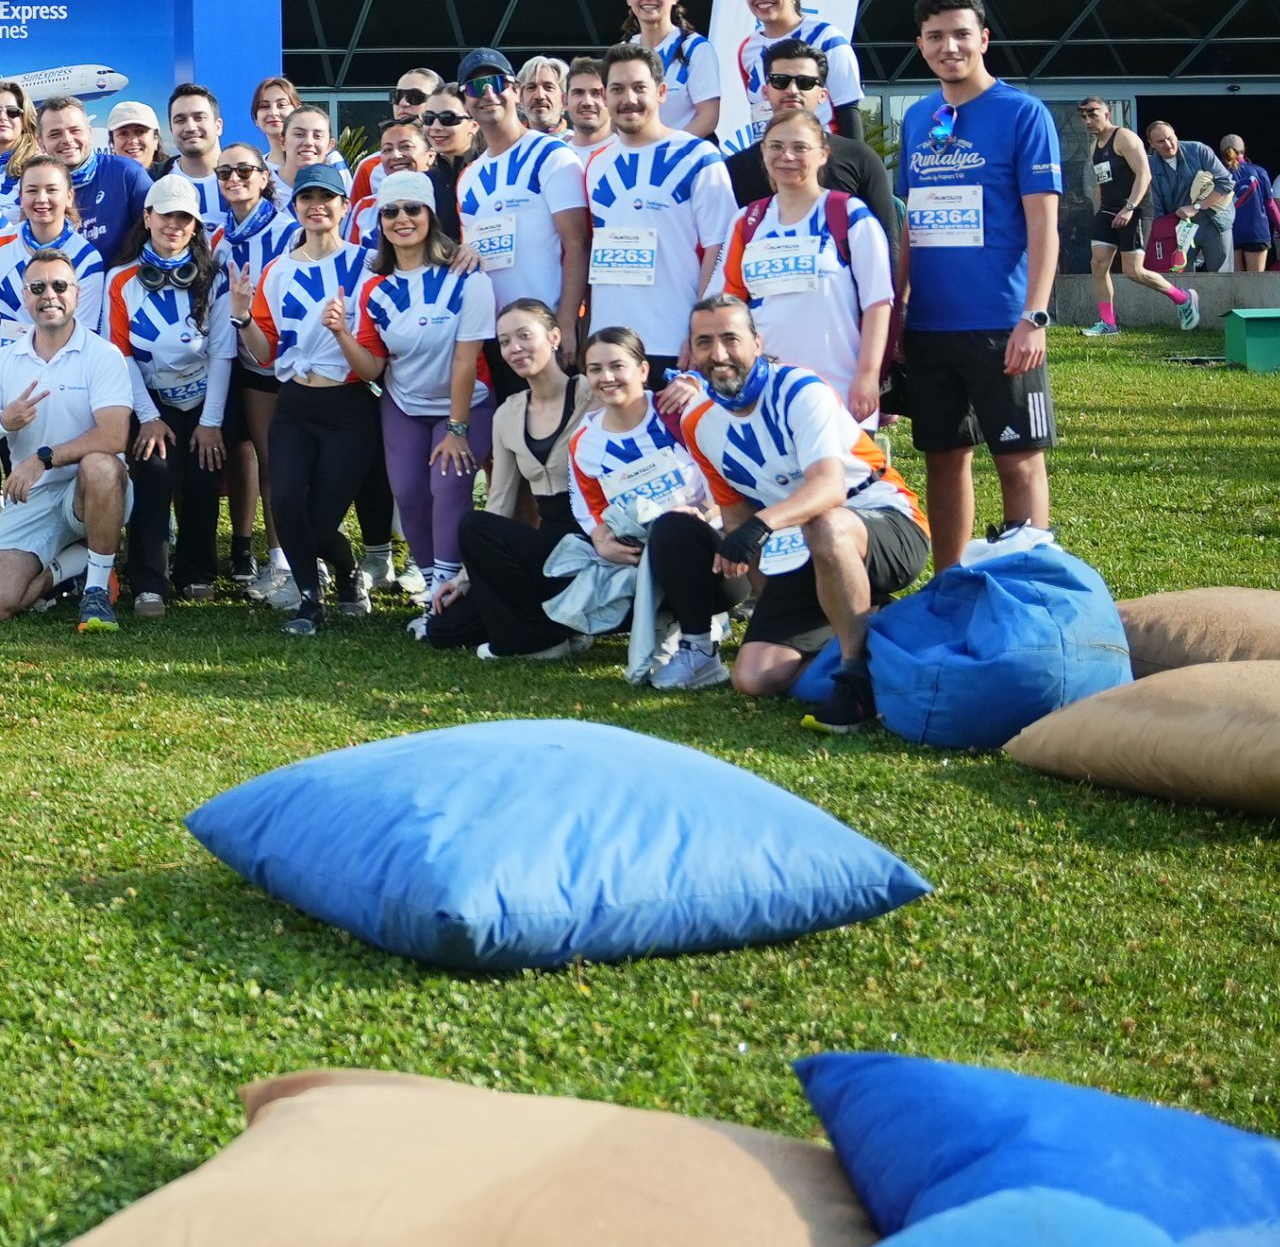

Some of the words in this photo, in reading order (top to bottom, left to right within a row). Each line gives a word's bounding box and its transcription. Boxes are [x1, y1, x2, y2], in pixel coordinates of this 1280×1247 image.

[911, 210, 977, 224] 12364
[473, 235, 512, 252] 2336
[595, 249, 652, 263] 12263
[746, 256, 813, 276] 12315
[768, 533, 806, 552] 123
